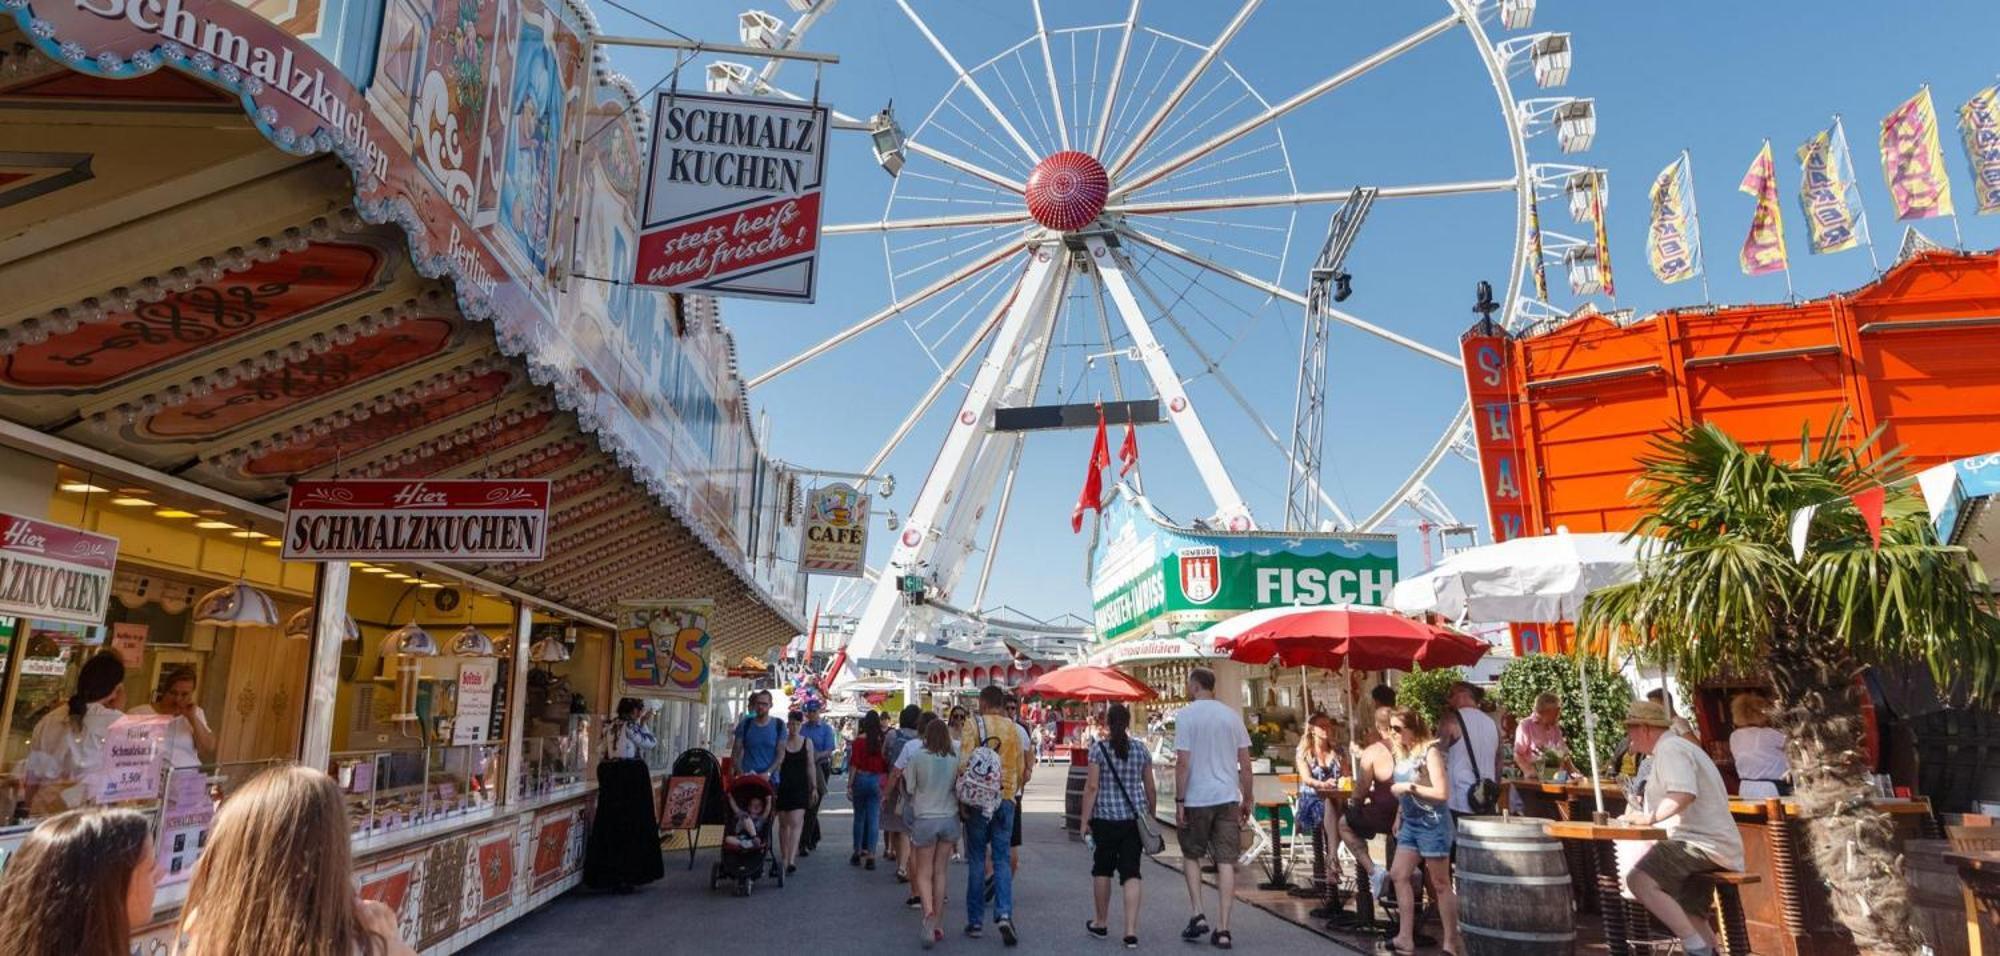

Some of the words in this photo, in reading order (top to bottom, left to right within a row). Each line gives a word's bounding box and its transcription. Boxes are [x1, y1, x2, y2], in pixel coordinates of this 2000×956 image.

[665, 107, 815, 154] SCHMALZ
[667, 148, 803, 195] KUCHEN
[664, 225, 729, 255] stets
[732, 200, 801, 239] heiß
[449, 223, 498, 298] Berliner
[647, 247, 711, 282] und
[393, 481, 447, 503] Hier
[3, 520, 46, 548] Hier
[292, 514, 539, 552] SCHMALZKUCHEN
[808, 525, 863, 545] CAFÉ
[1257, 567, 1393, 605] FISCH
